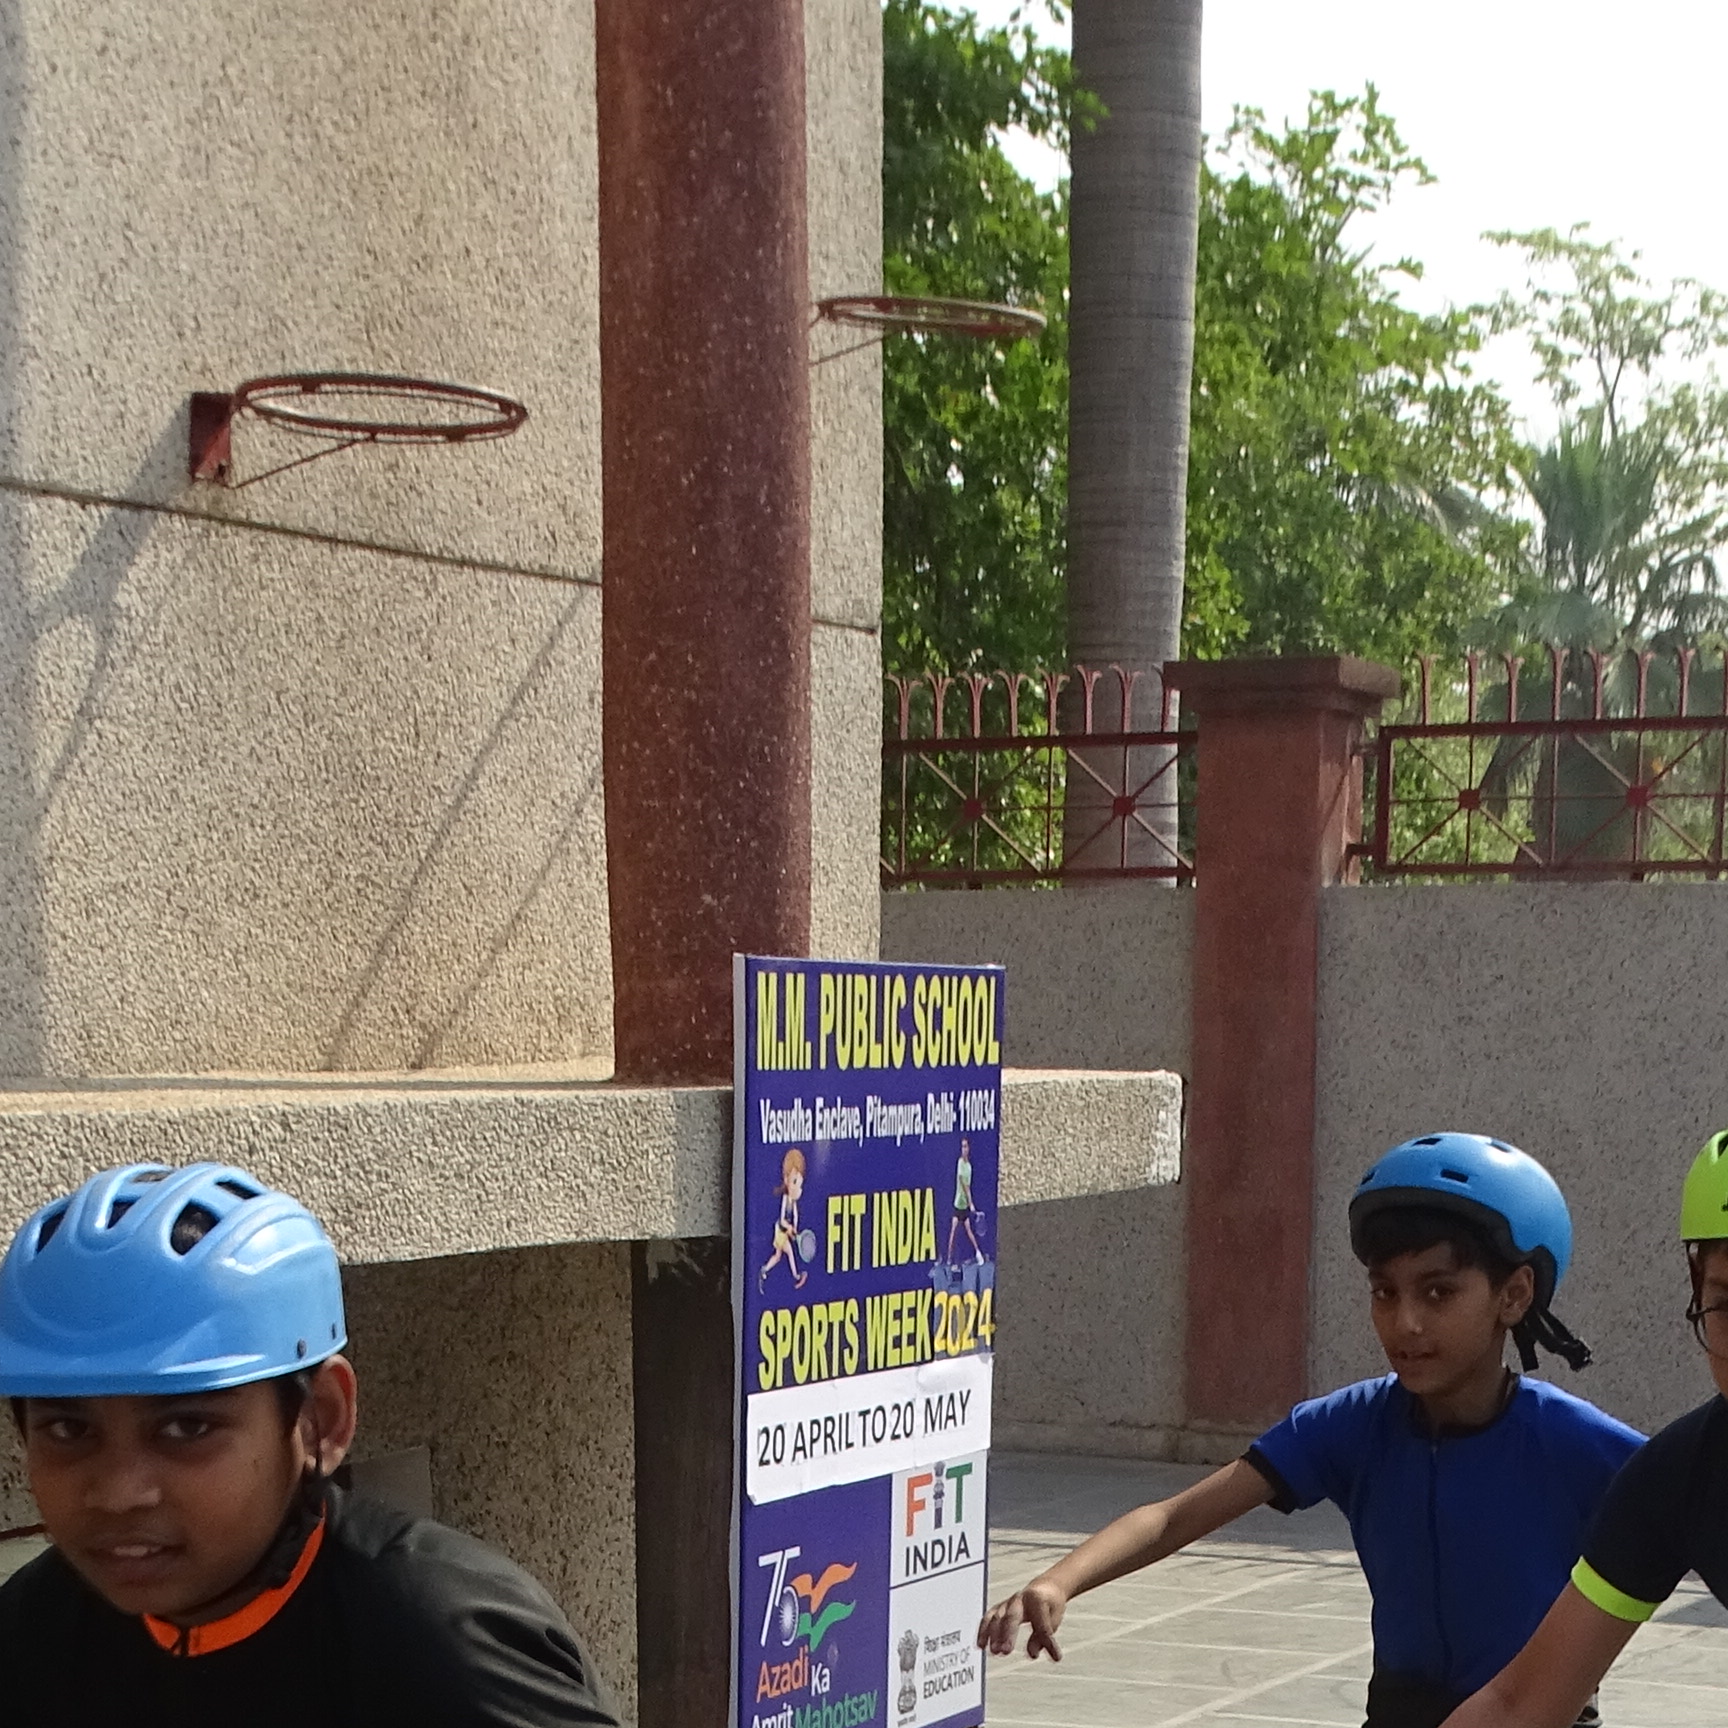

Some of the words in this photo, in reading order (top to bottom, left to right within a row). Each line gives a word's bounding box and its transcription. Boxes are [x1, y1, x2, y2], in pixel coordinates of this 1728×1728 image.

[756, 971, 812, 1071] M.M.
[819, 972, 908, 1070] PUBLIC
[912, 975, 1000, 1069] SCHOOL
[760, 1097, 813, 1145] Vasudha
[815, 1096, 863, 1148] Enclave,
[865, 1095, 924, 1146] Pitampura,
[958, 1089, 995, 1132] 110034
[826, 1193, 867, 1273] FIT
[871, 1187, 937, 1268] INDIA
[758, 1299, 860, 1391] SPORTS
[864, 1288, 933, 1373] WEEK
[933, 1289, 996, 1357] 2024
[757, 1426, 786, 1467] 20
[791, 1413, 855, 1464] APRIL
[857, 1405, 887, 1447] TO
[890, 1400, 915, 1441] 20
[924, 1389, 972, 1435] MAY
[905, 1532, 971, 1577] INDIA
[756, 1650, 810, 1703] Azadi
[811, 1663, 831, 1695] Ka
[923, 1665, 974, 1699] EDUCATION
[960, 1646, 970, 1664] OF
